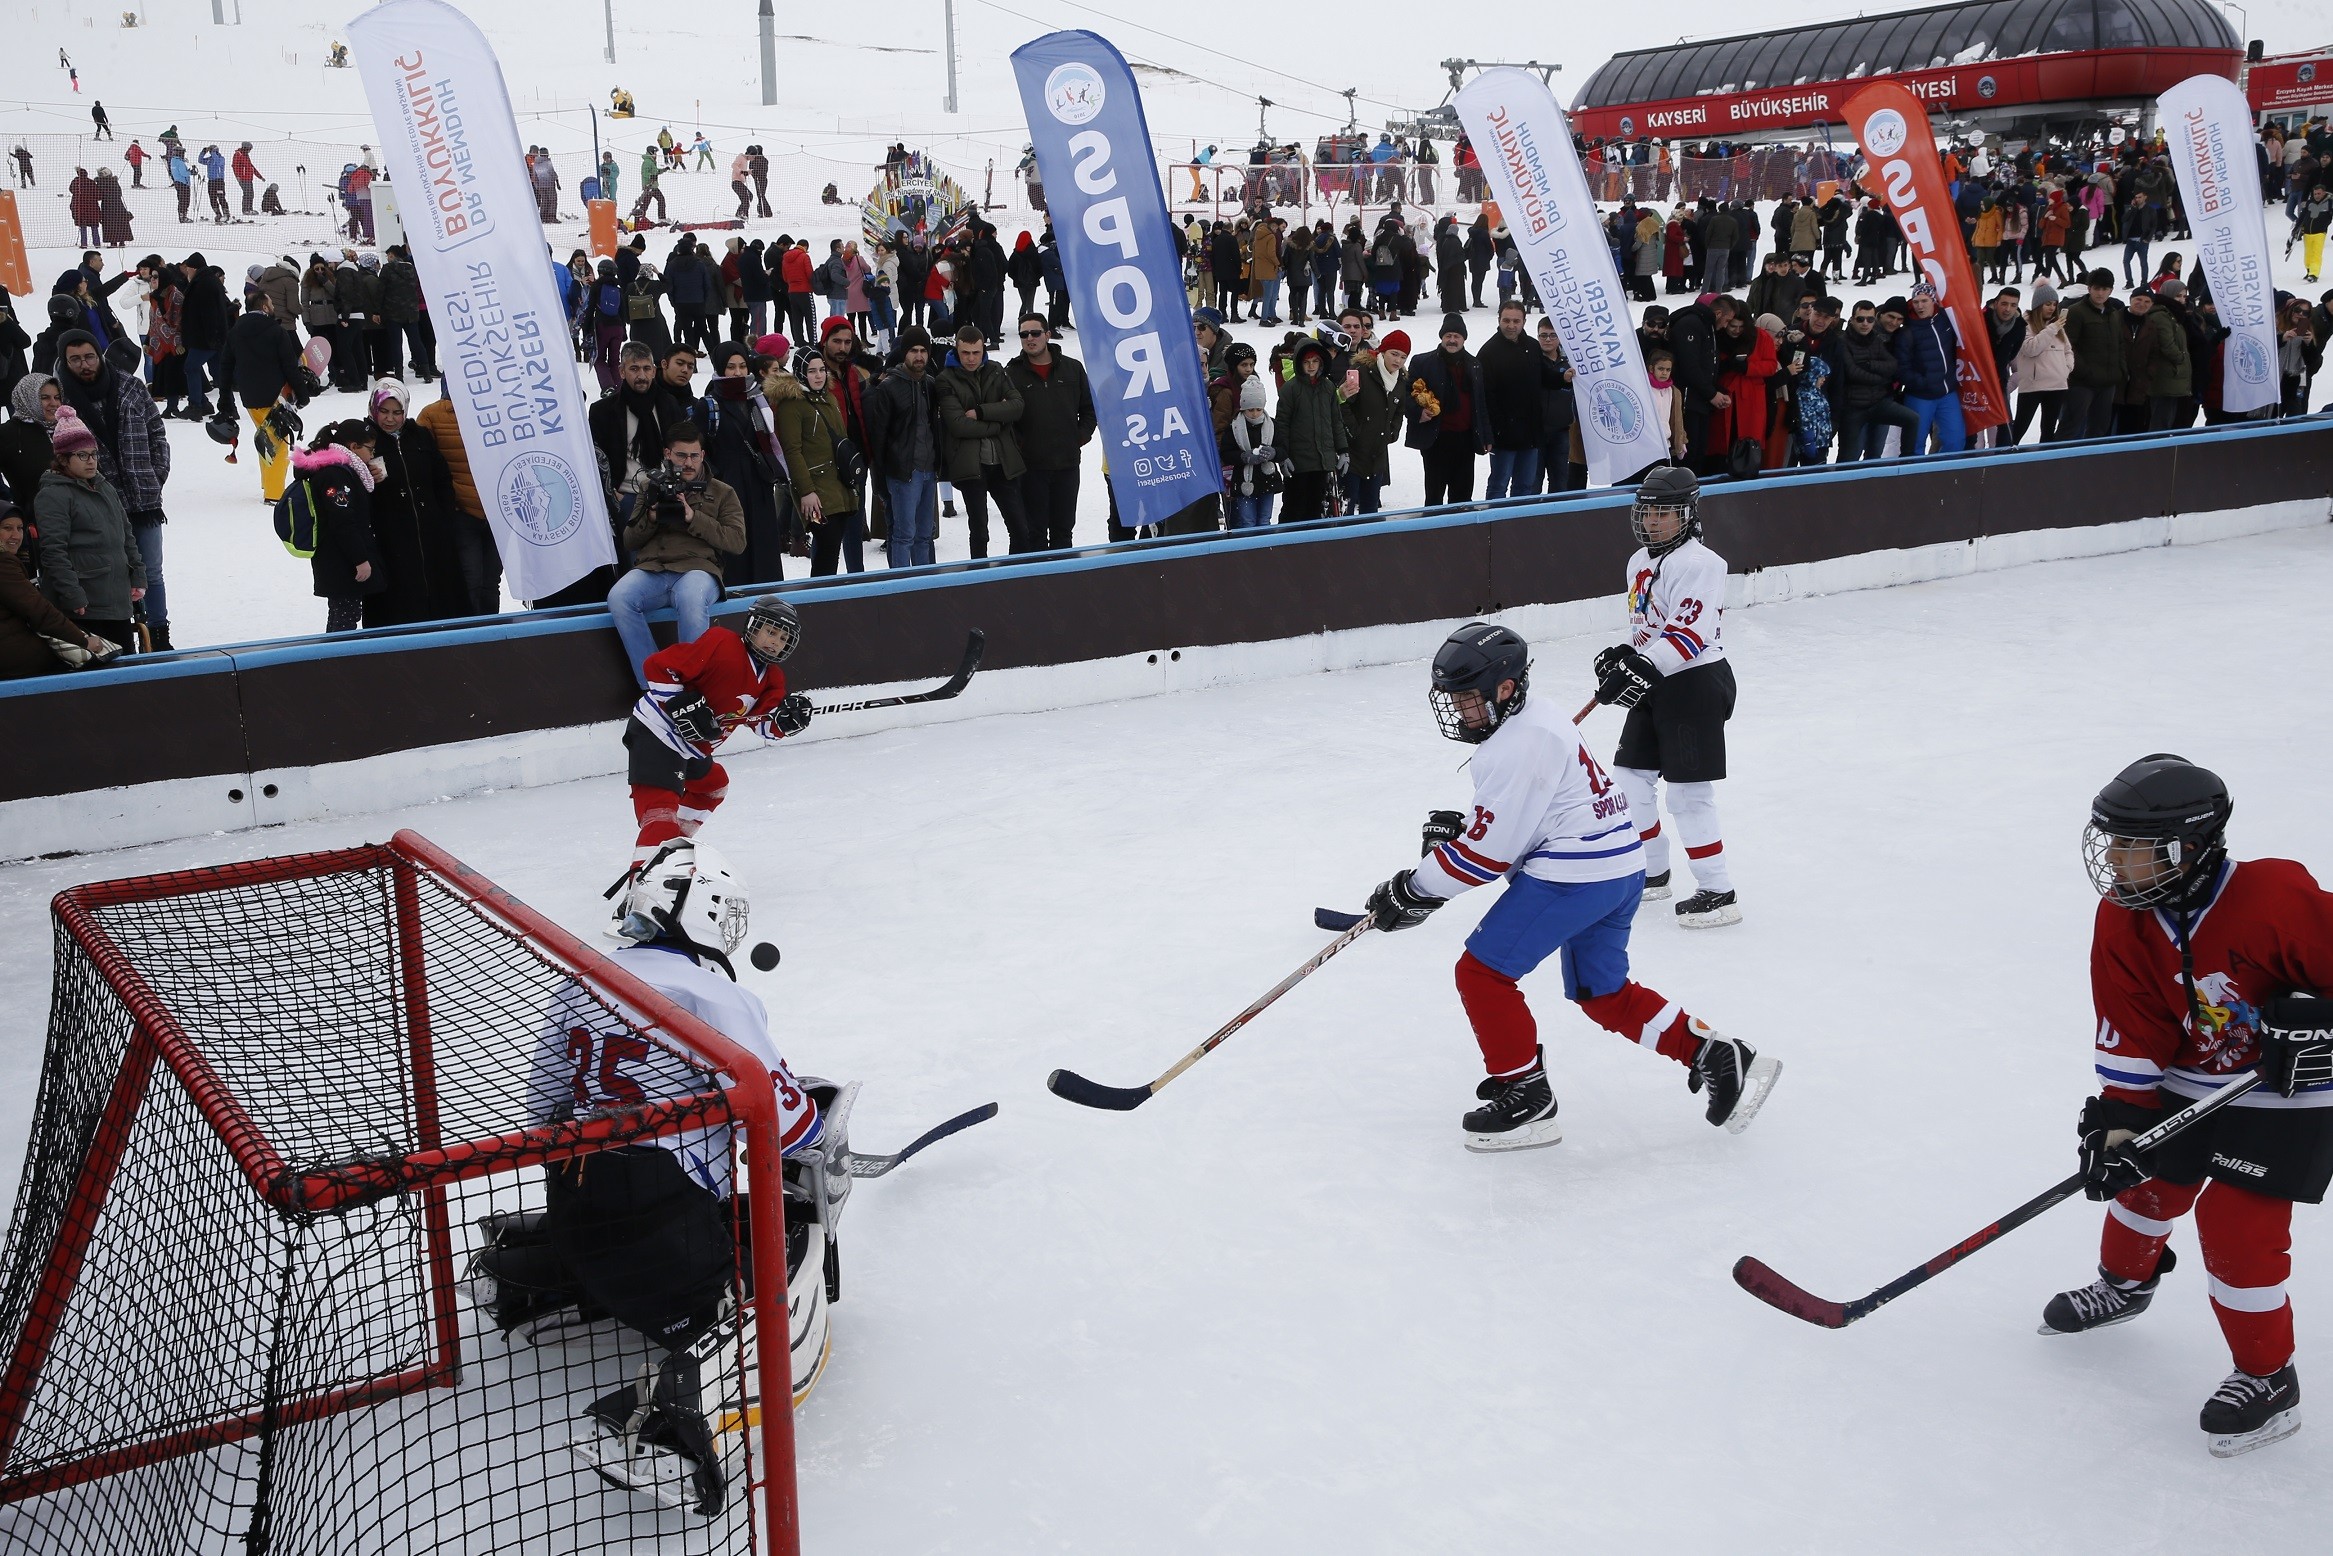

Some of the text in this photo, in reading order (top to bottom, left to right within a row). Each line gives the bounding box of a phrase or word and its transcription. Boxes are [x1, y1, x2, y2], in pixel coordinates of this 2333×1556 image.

[1647, 104, 1706, 128] KAYSERİ
[1730, 94, 1829, 120] BÜYÜKŞEHİR
[1674, 597, 1704, 626] 23
[1477, 629, 1503, 646] EASTON
[2211, 1152, 2268, 1178] Pallas
